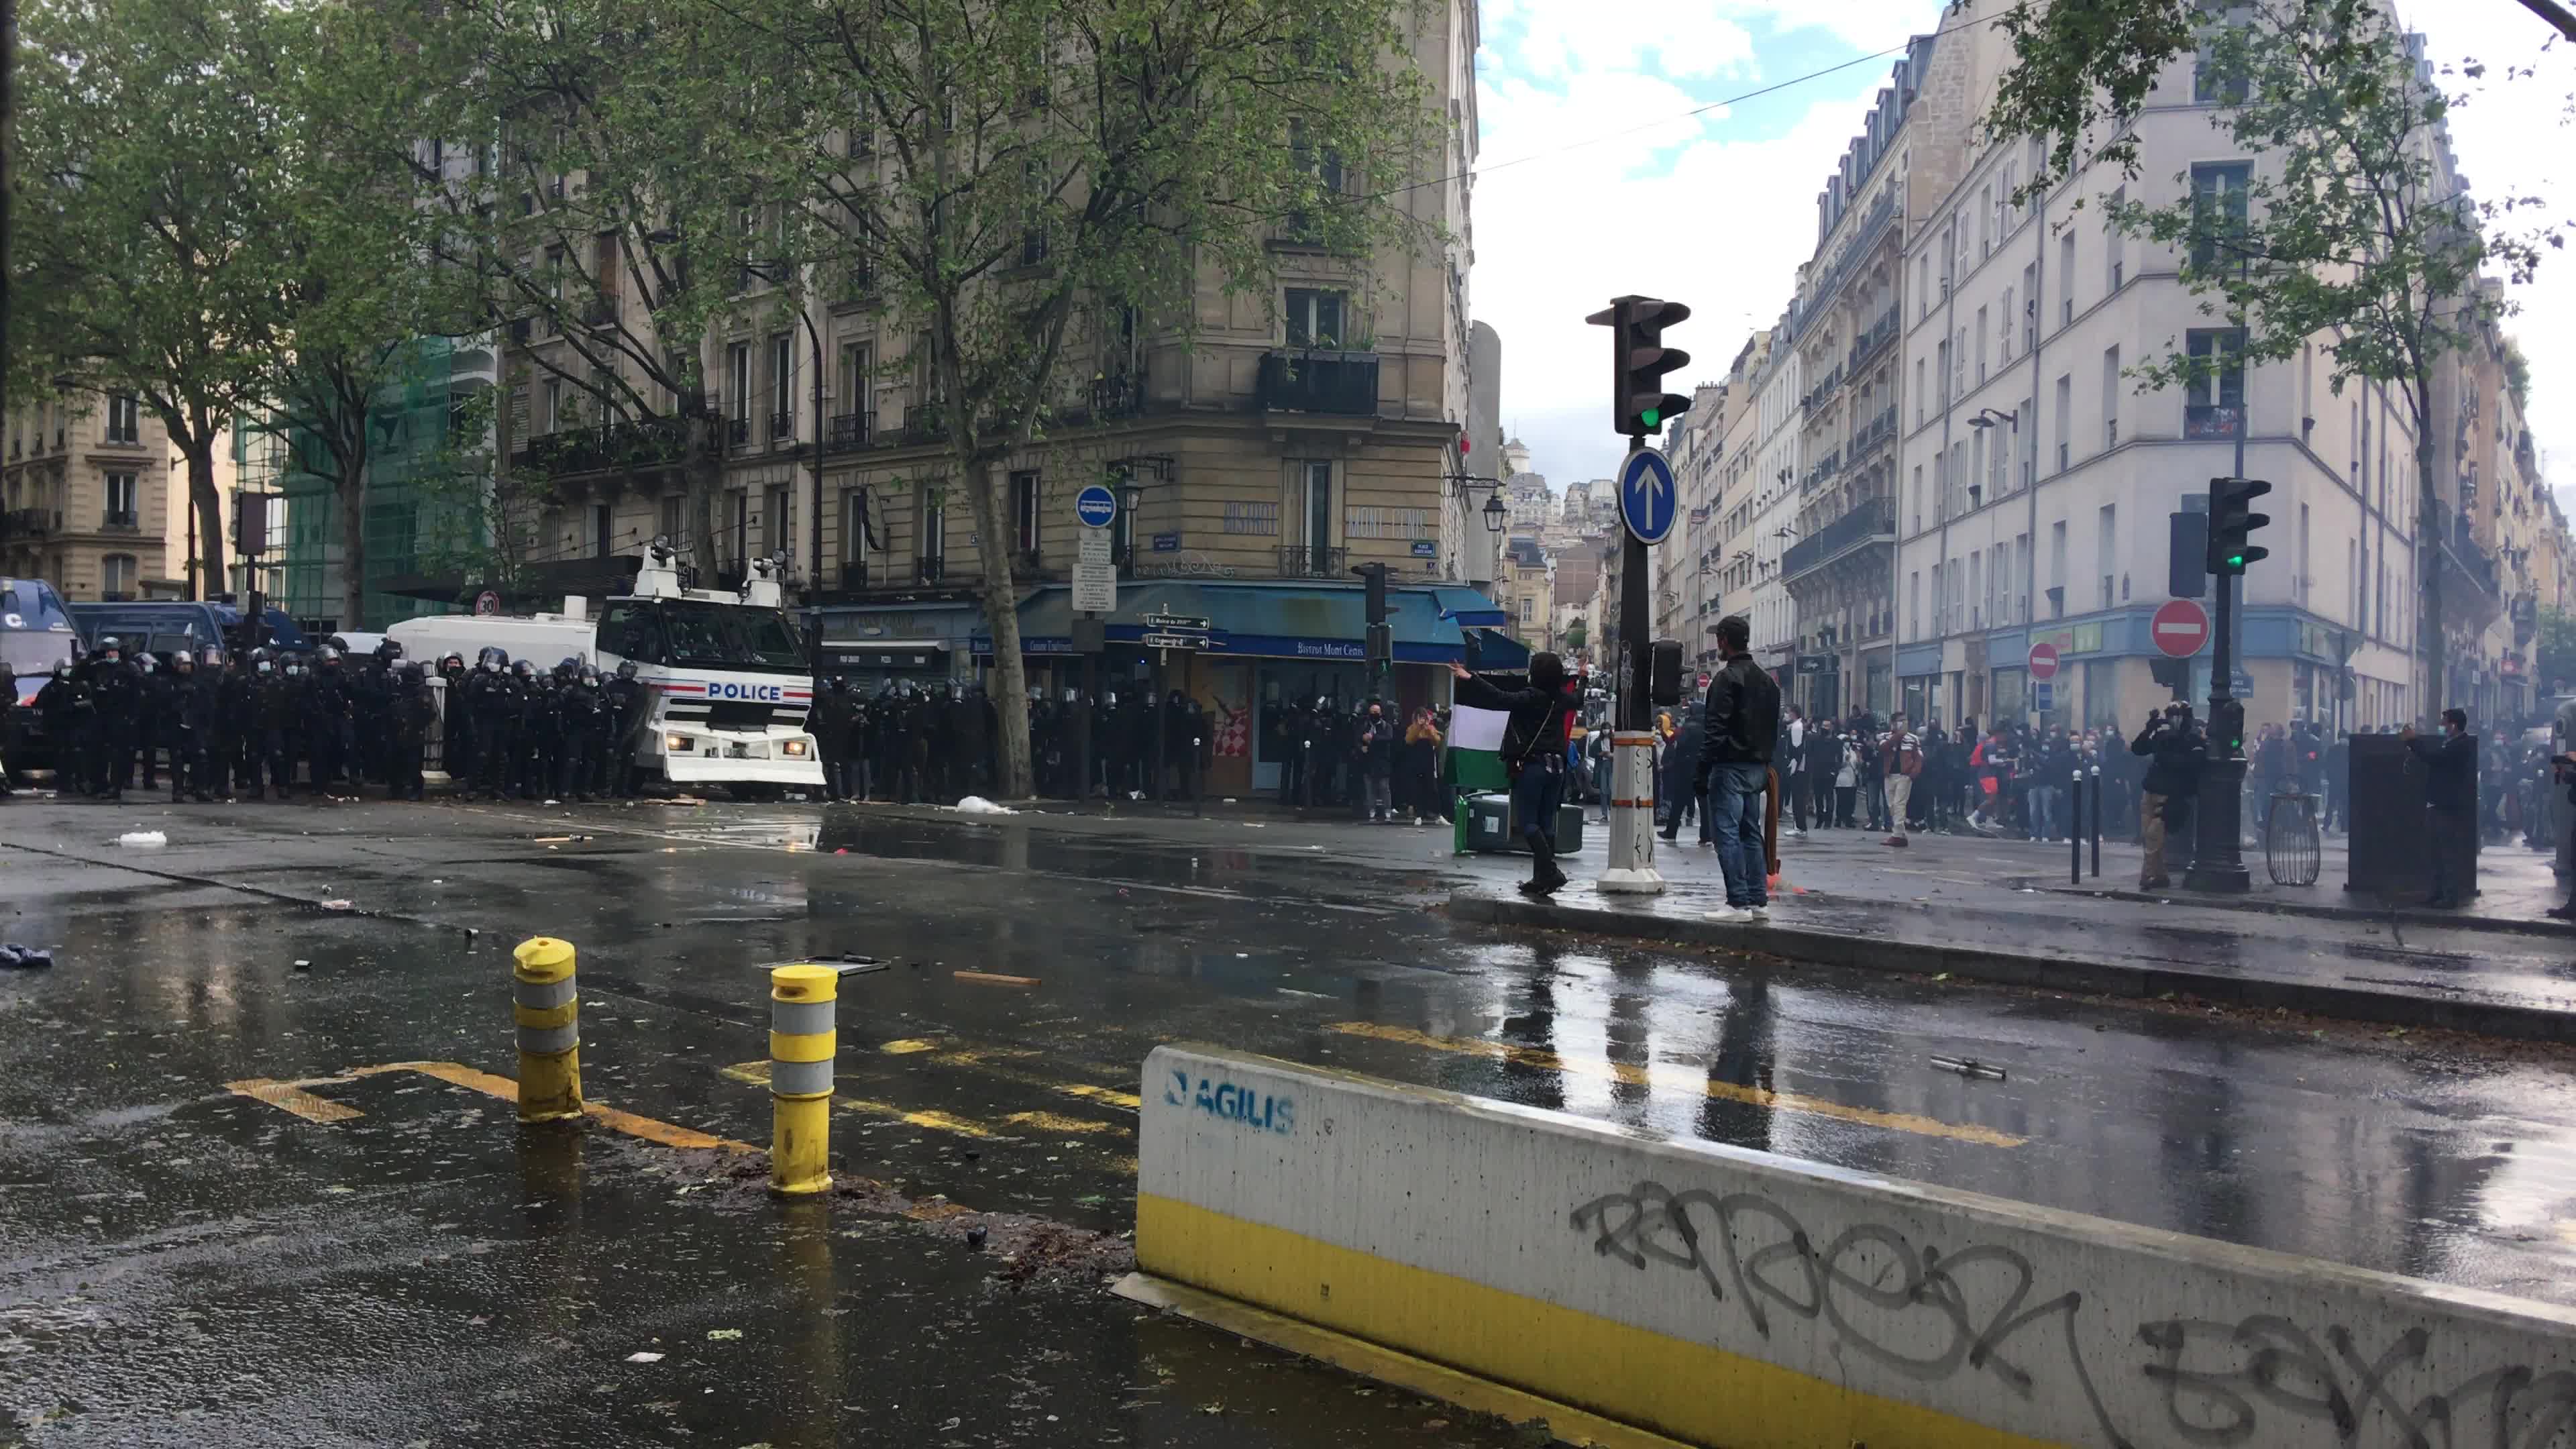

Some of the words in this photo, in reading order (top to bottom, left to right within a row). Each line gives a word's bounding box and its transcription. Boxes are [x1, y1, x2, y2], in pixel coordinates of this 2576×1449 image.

[481, 600, 494, 612] 30
[1298, 641, 1322, 655] Bistrot
[1324, 643, 1342, 655] Mont
[1344, 644, 1364, 655] Cenis
[708, 683, 781, 701] POLICE
[1196, 1078, 1295, 1134] AGILIS
